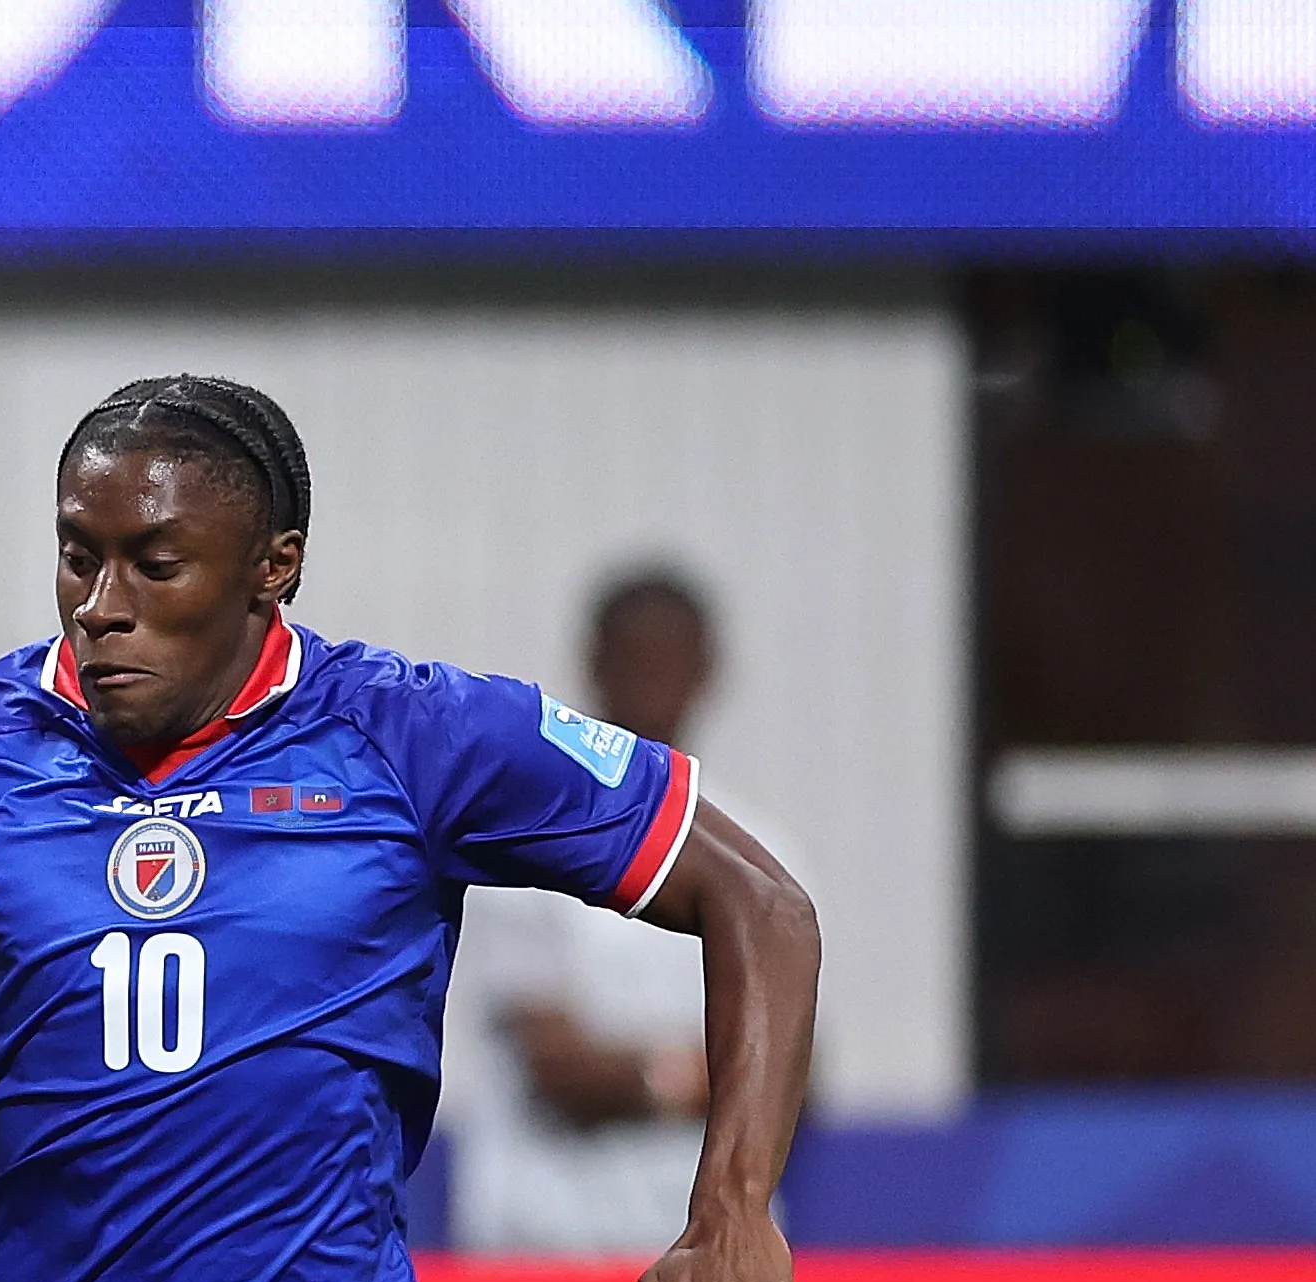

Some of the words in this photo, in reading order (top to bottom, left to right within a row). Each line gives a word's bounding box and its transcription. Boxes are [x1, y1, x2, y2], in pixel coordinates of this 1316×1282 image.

[93, 791, 224, 818] SAETA
[138, 842, 172, 853] HAITI
[90, 931, 206, 1073] 10
